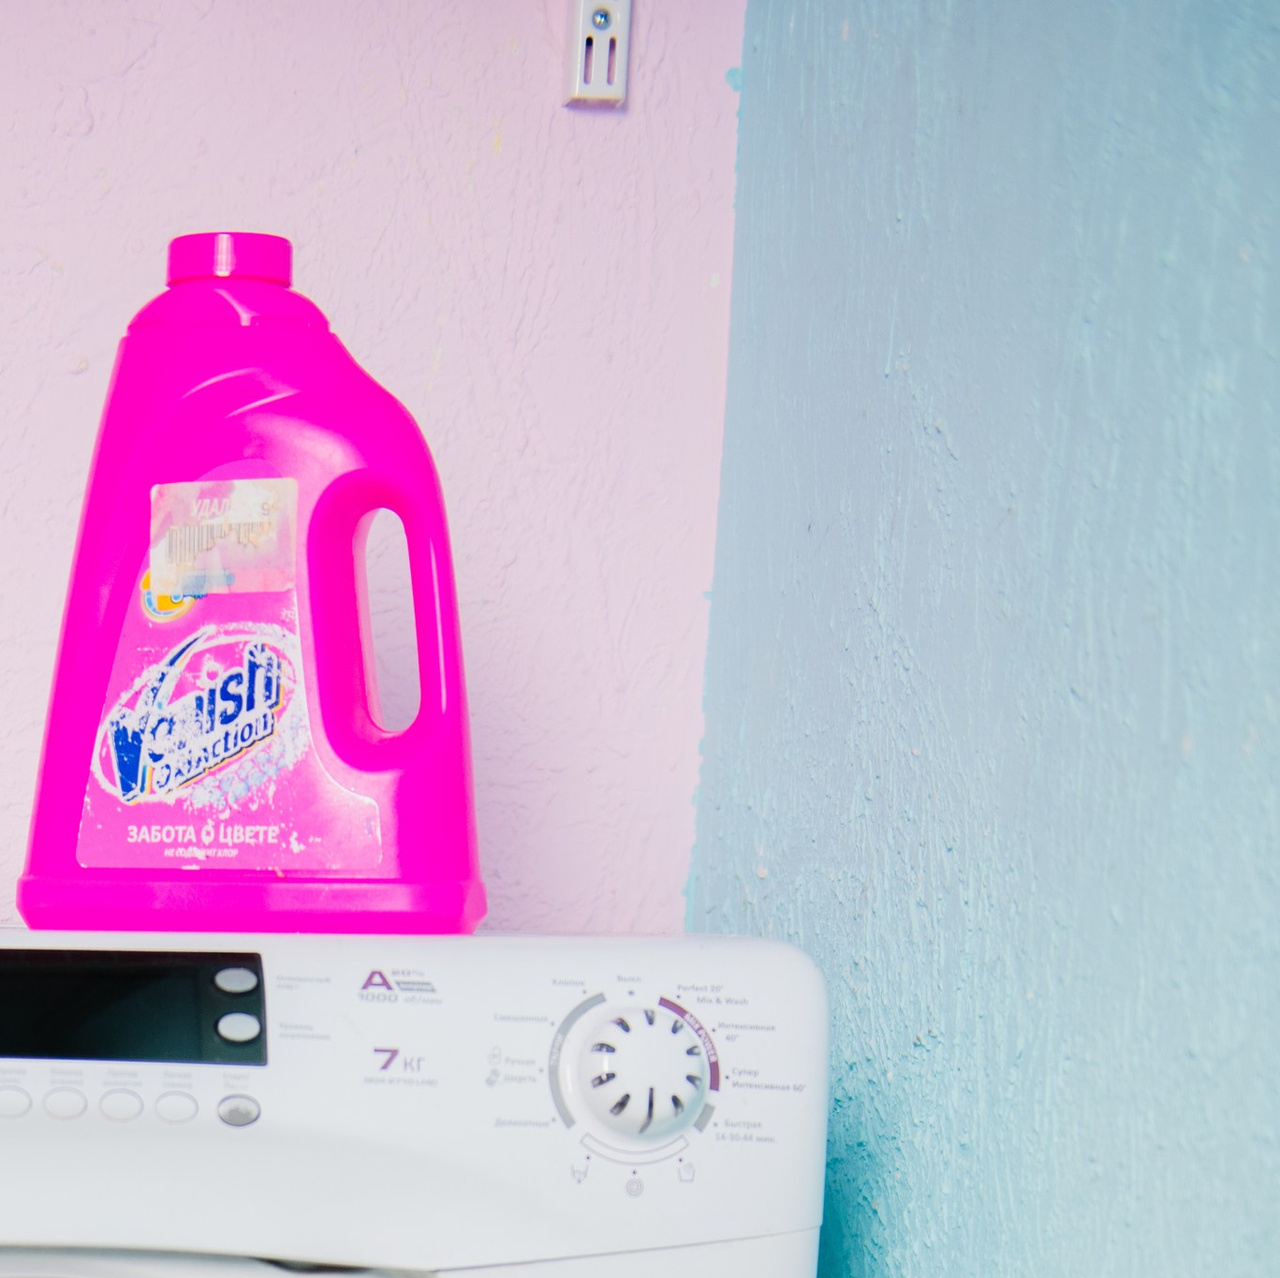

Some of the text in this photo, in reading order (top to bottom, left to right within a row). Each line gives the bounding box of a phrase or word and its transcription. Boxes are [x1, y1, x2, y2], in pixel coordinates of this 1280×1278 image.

[127, 825, 197, 843] ЗАБОТА
[218, 825, 280, 846] ЦВЕТЕ
[373, 1048, 400, 1071] 7
